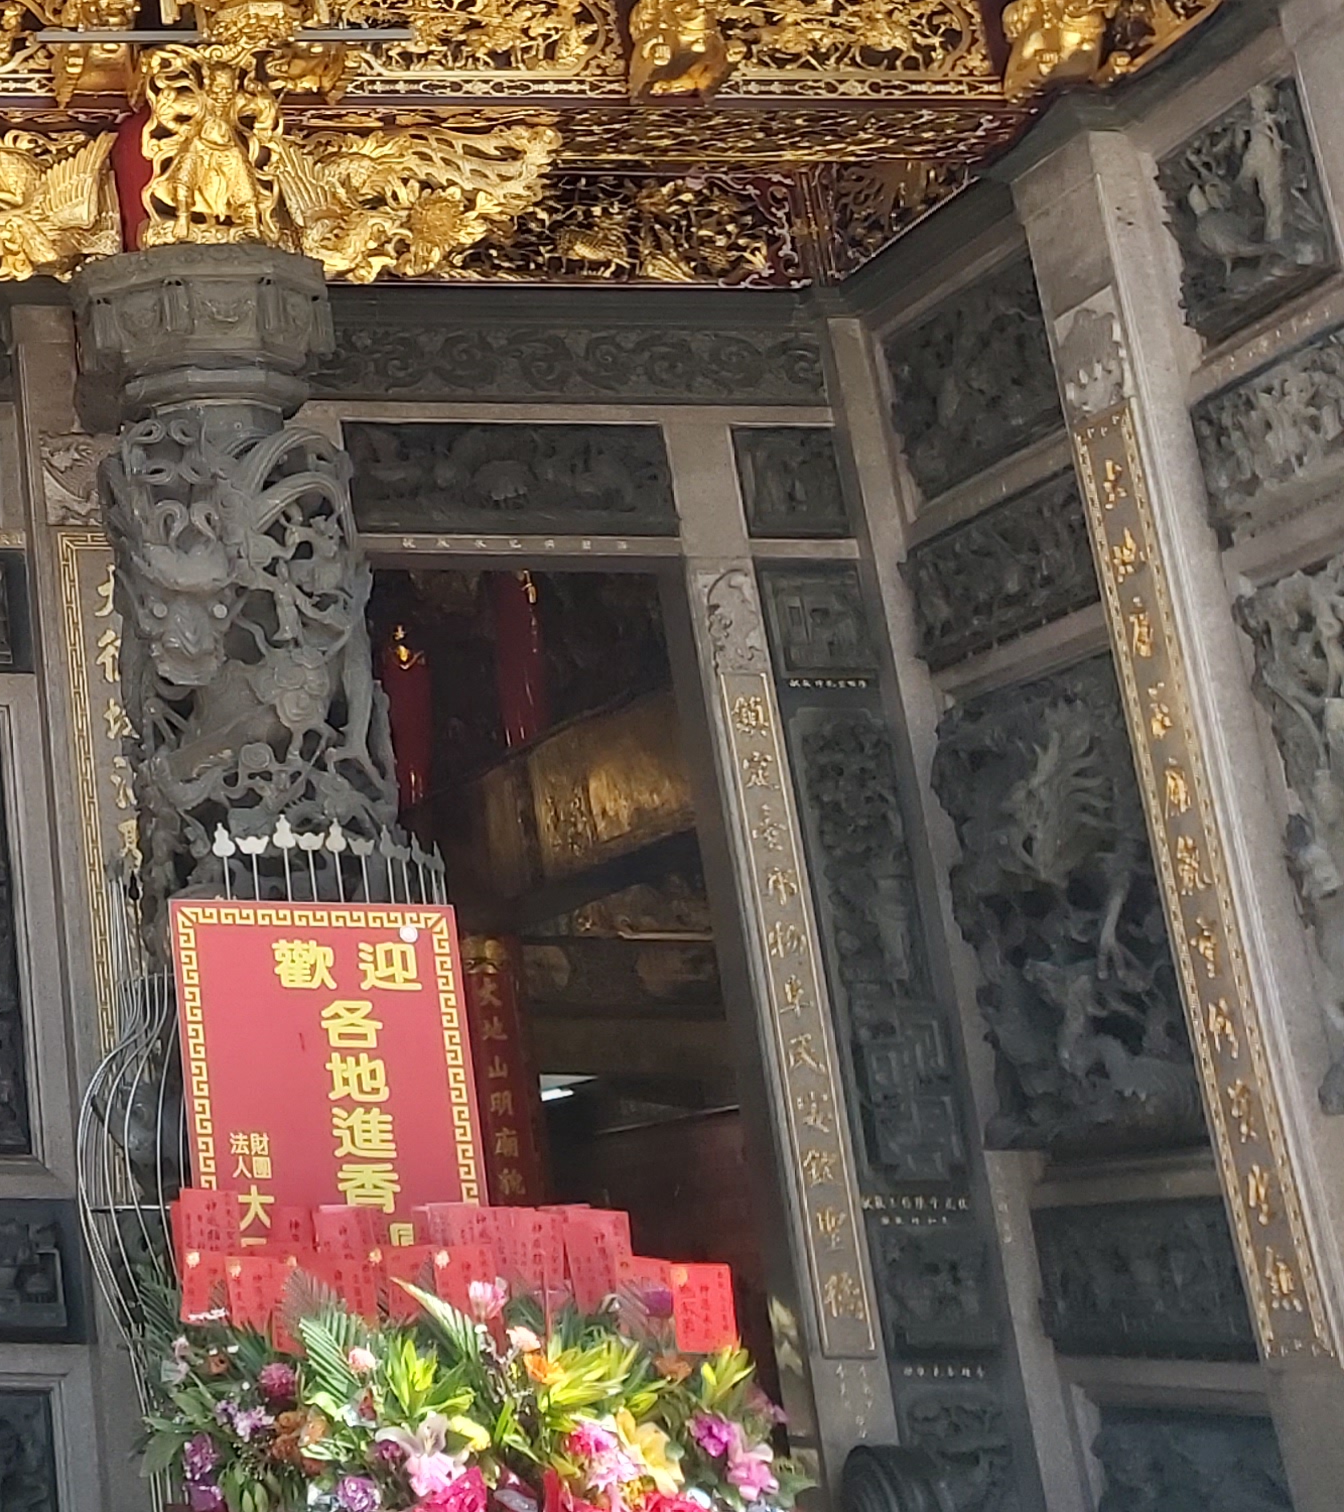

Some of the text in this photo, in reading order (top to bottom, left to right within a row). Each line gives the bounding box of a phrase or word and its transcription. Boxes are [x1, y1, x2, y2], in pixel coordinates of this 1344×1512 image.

[272, 939, 423, 991] 歡迎
[320, 1000, 414, 1246] 各地進香
